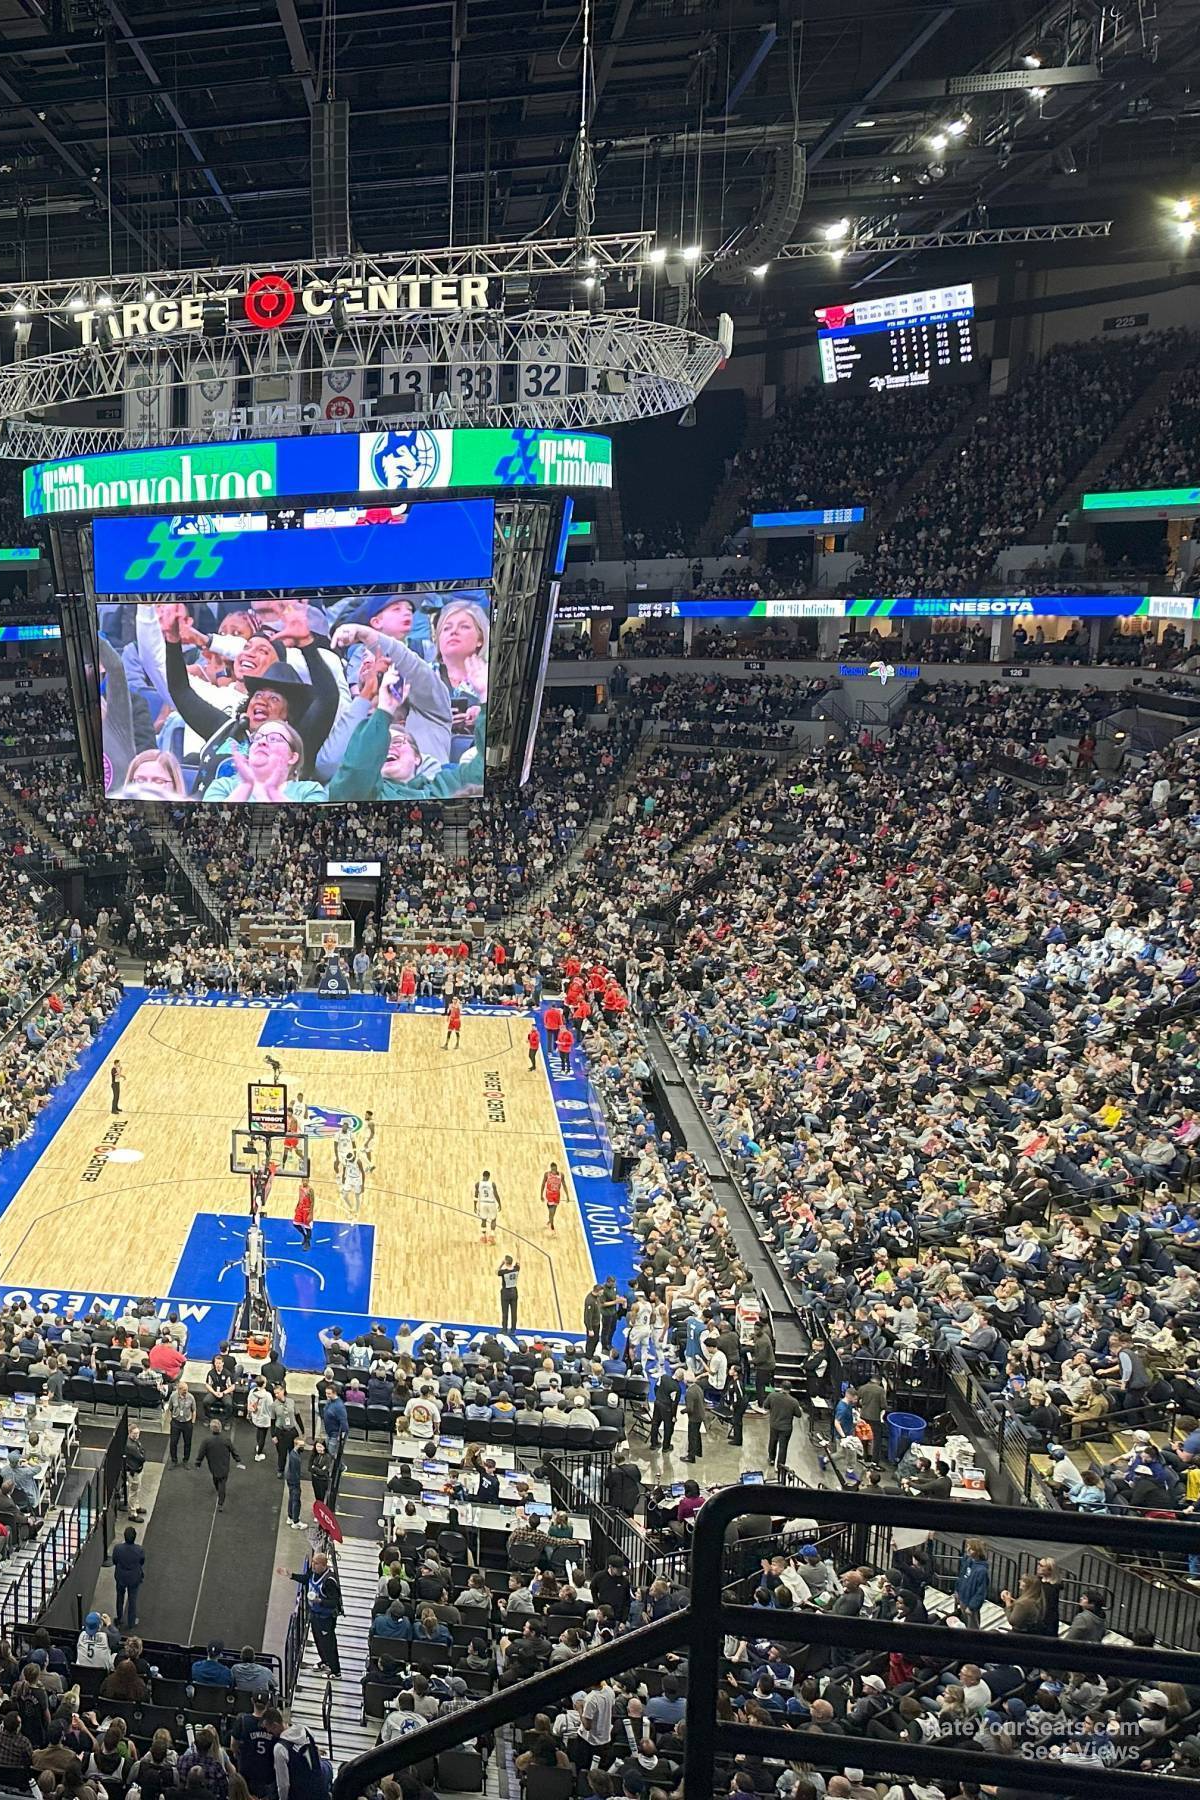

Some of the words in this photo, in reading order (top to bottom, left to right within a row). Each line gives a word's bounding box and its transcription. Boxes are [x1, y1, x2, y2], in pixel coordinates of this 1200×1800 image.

[302, 274, 489, 316] CENTER
[1115, 317, 1136, 328] 225
[389, 370, 423, 394] 13
[456, 366, 492, 401] 33
[524, 364, 563, 398] 32
[278, 510, 295, 519] 4:49
[315, 508, 336, 526] 52
[914, 602, 1034, 613] MINNESOTA
[1009, 669, 1023, 677] 126
[323, 893, 339, 904] 24
[143, 998, 299, 1009] MINNESOTA
[415, 1005, 531, 1017] beway
[484, 1071, 502, 1092] TARGET
[487, 1099, 506, 1123] CENTER
[101, 1120, 129, 1145] TARGET
[79, 1154, 109, 1182] CENTER
[353, 1359, 364, 1368] 21
[971, 1480, 980, 1488] G
[319, 1508, 336, 1530] TCL
[86, 1645, 94, 1658] 5
[257, 1741, 266, 1754] 5
